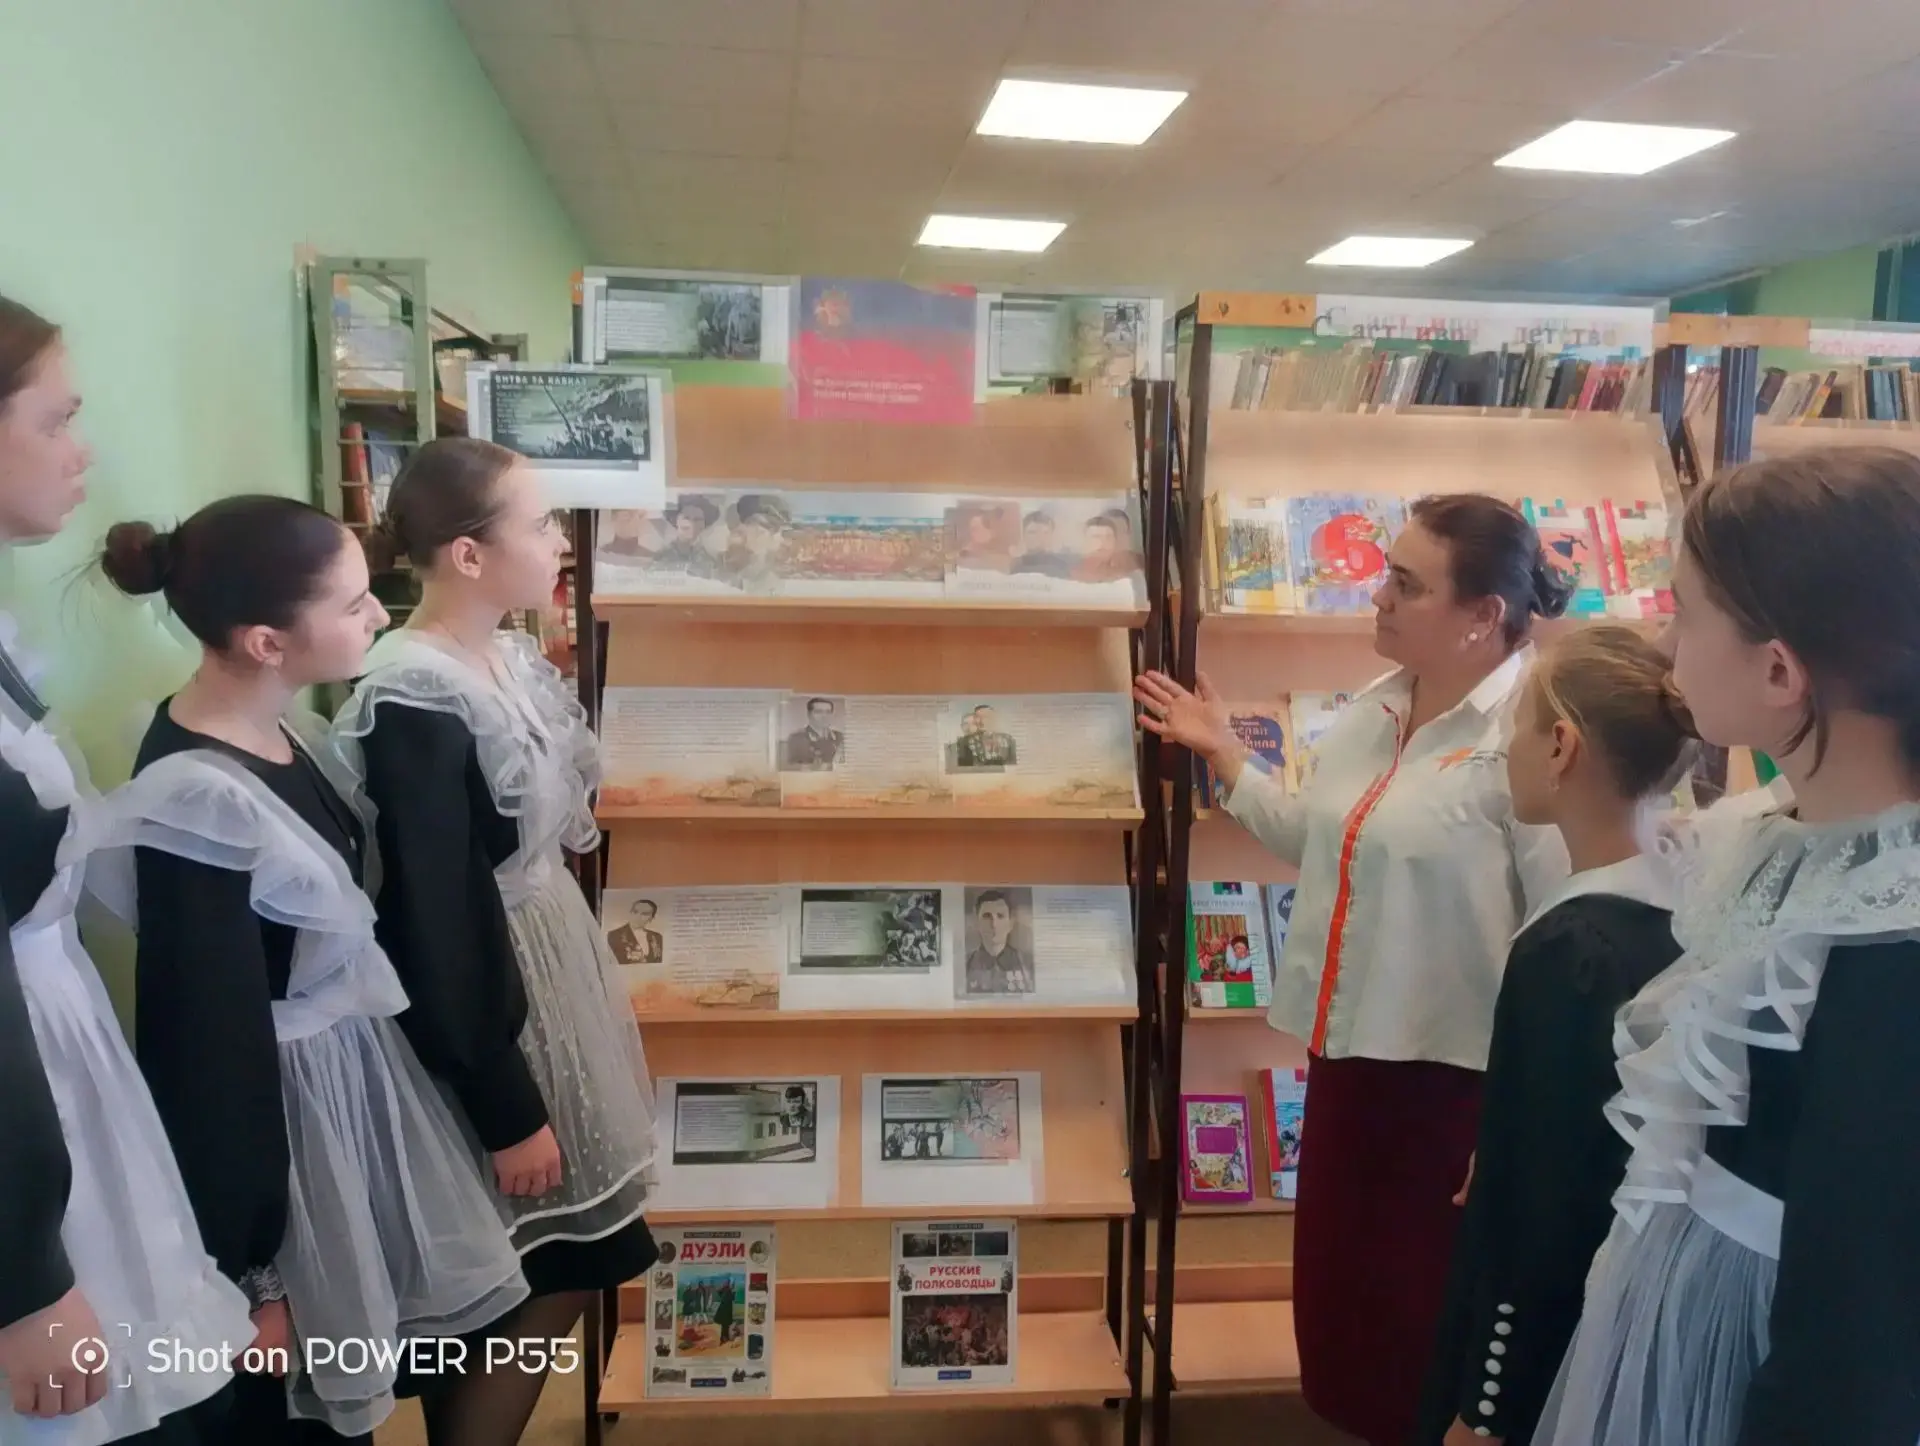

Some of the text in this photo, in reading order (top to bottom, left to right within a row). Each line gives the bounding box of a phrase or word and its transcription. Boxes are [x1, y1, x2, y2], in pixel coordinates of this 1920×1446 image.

[680, 1242, 746, 1260] ДУЭЛИ
[929, 1264, 982, 1276] РУССКИЕ
[914, 1278, 996, 1290] ПОЛКОВОДЦЫ
